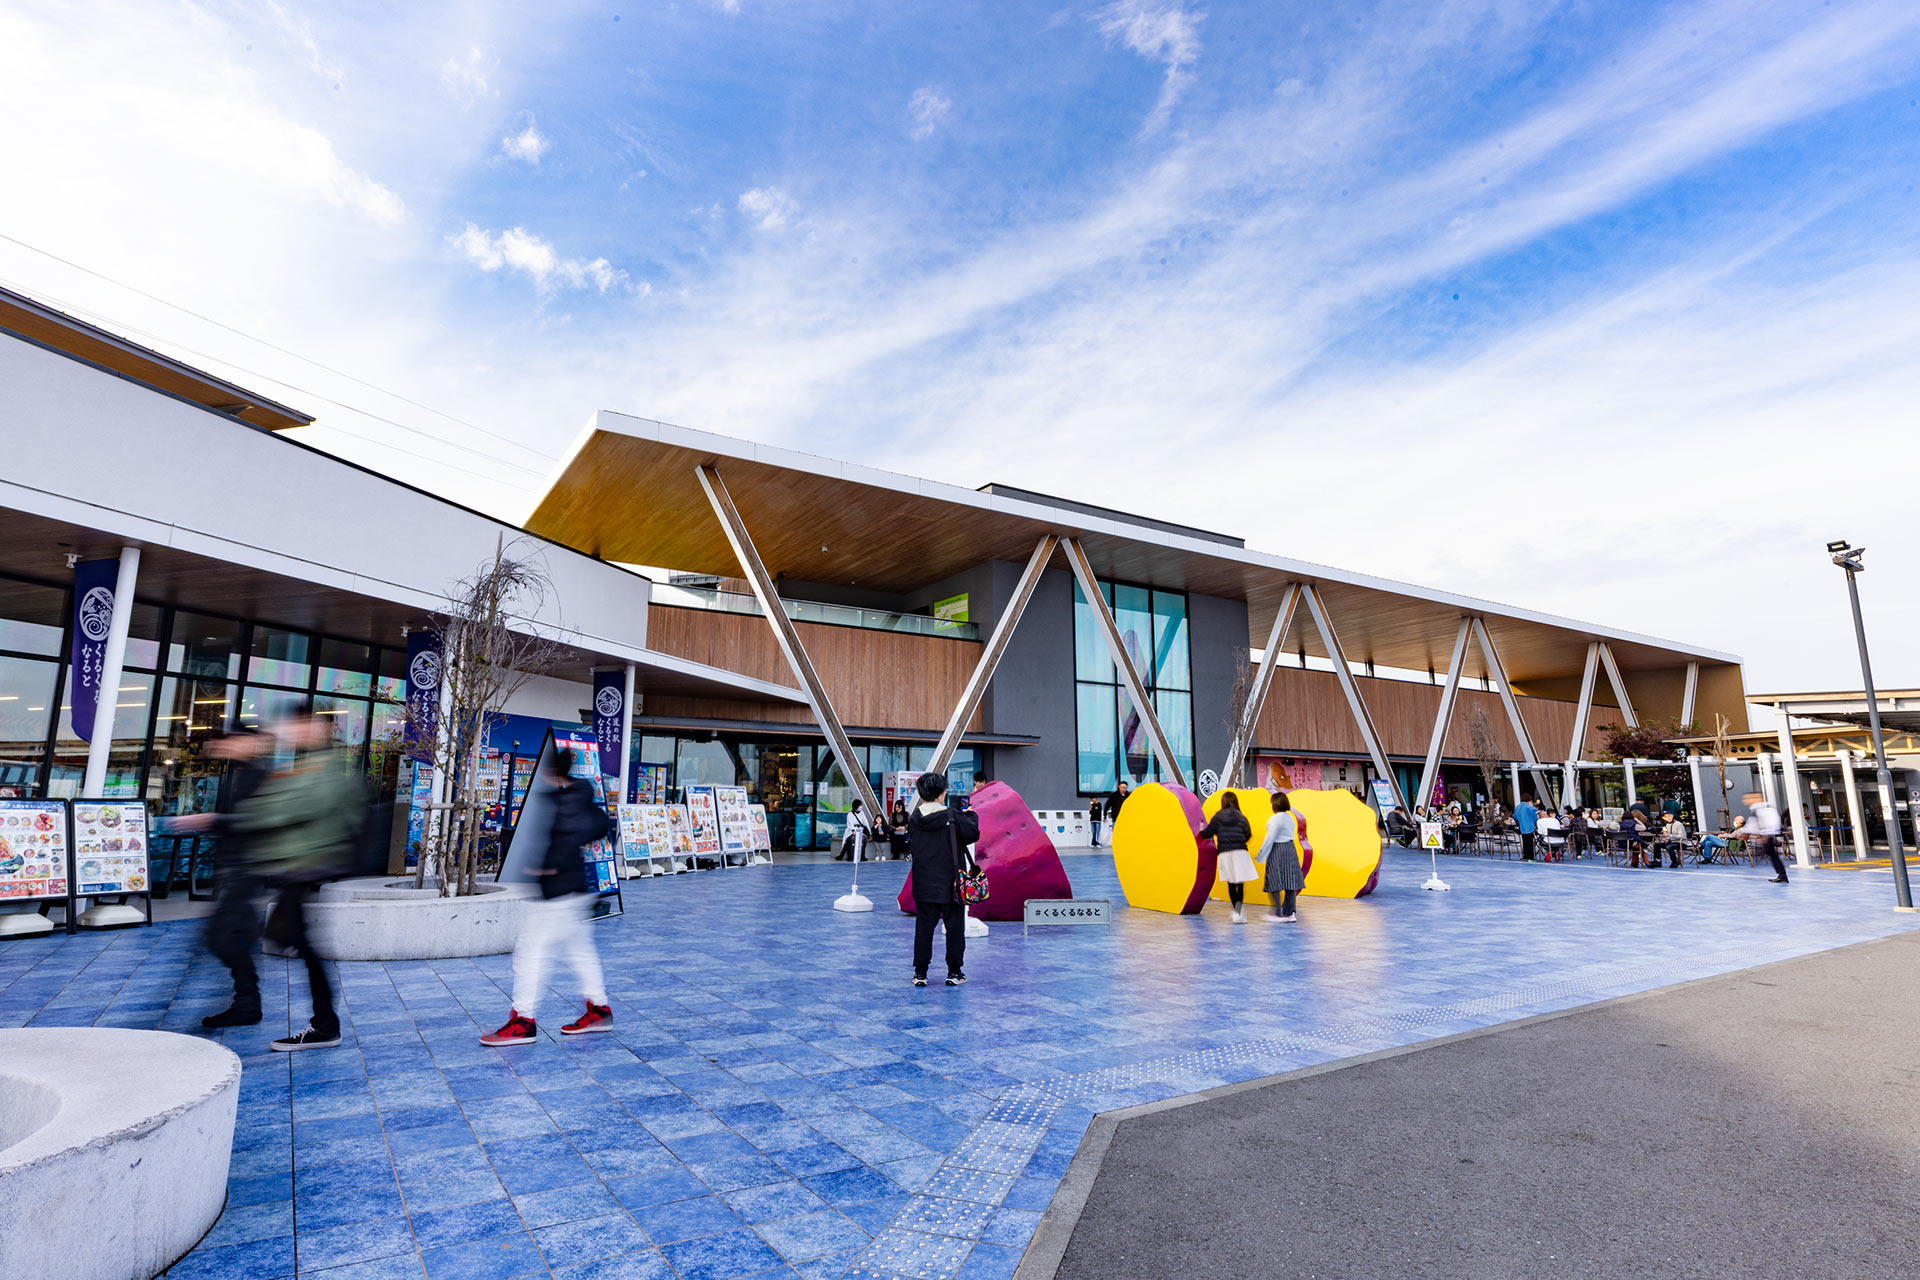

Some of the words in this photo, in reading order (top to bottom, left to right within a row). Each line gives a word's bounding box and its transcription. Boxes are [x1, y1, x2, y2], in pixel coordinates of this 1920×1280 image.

[81, 643, 92, 687] なると
[1035, 908, 1101, 917] #くるくるなると
